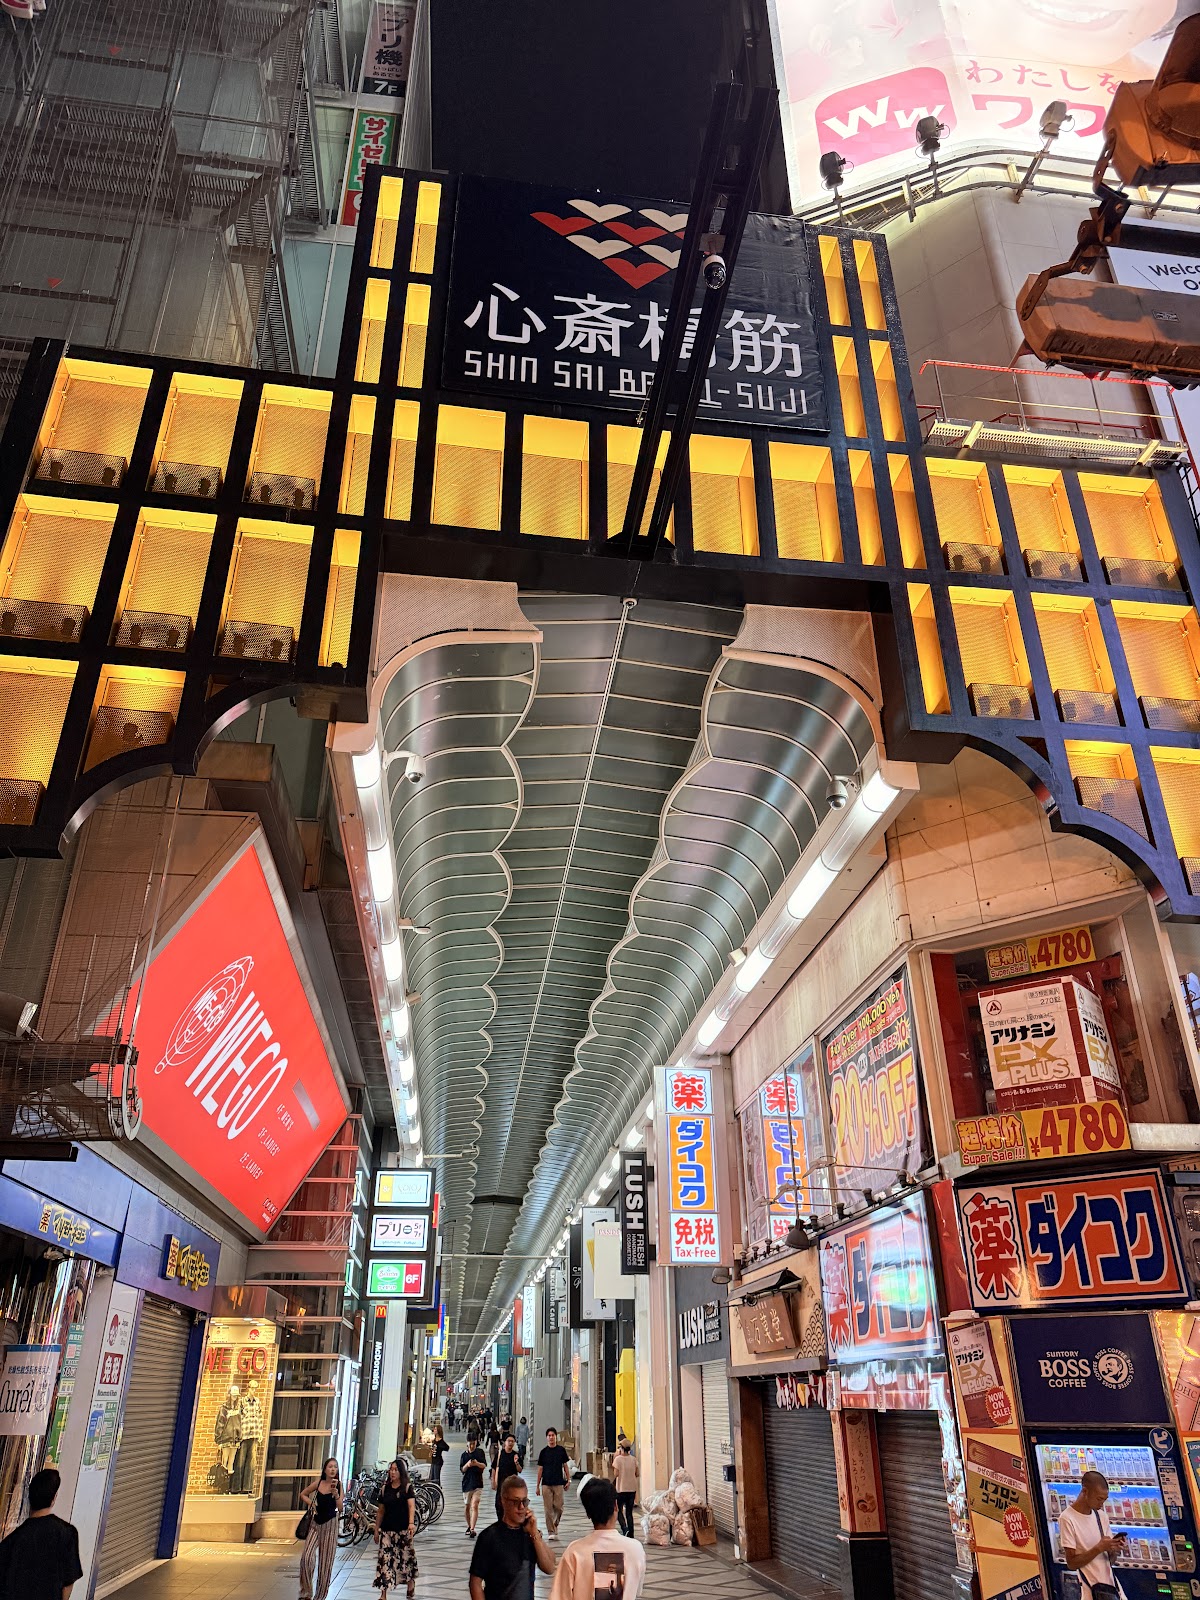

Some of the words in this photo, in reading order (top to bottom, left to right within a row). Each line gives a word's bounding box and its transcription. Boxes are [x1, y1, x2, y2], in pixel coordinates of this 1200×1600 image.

[374, 80, 398, 95] 7F
[965, 60, 1119, 94] わたしを
[464, 283, 801, 377] 心斎橋筋
[464, 350, 537, 383] SHIN
[554, 360, 603, 391] SAI
[1030, 930, 1092, 969] ¥4780
[991, 968, 1010, 978] Super
[842, 1028, 857, 1046] Over
[859, 1001, 886, 1031] 100,000
[886, 988, 900, 1007] Yen
[990, 1021, 1056, 1045] アリナミン
[993, 1037, 1058, 1073] EX
[1086, 1034, 1110, 1065] EX
[184, 991, 288, 1140] WEGO
[1009, 1057, 1071, 1086] PLUS
[672, 1073, 705, 1111] 薬
[1029, 1102, 1125, 1158] ¥4780
[677, 1120, 706, 1206] ダイコク
[963, 1153, 990, 1165] Super
[625, 1160, 645, 1229] LUSH
[674, 1217, 715, 1246] 免税
[967, 1200, 1022, 1294] 薬
[1028, 1189, 1166, 1288] ダイコク
[636, 1233, 645, 1267] FRESH
[675, 1246, 716, 1258] Tax-Free
[406, 1274, 419, 1284] 6F
[825, 1243, 850, 1347] 薬
[680, 1306, 705, 1350] LUSH
[372, 1341, 382, 1390] McDonald's
[955, 1349, 985, 1366] アリナミン
[1038, 1359, 1092, 1378] BOSS
[1095, 1348, 1107, 1360] BOSS
[1107, 1347, 1128, 1359] COFFEE
[1126, 1359, 1135, 1375] BOSS
[959, 1360, 987, 1384] EX
[967, 1374, 995, 1393] PLUS
[1048, 1379, 1087, 1388] COFFEE
[988, 1391, 1004, 1402] NOW
[1176, 1383, 1198, 1399] DHC
[993, 1400, 1005, 1409] ON
[993, 1407, 1011, 1418] SALE!
[979, 1478, 1020, 1503] パブロン
[1005, 1512, 1022, 1523] NOW
[1010, 1521, 1023, 1531] ON
[1010, 1530, 1029, 1541] SALE!
[1022, 1581, 1035, 1595] EVE
